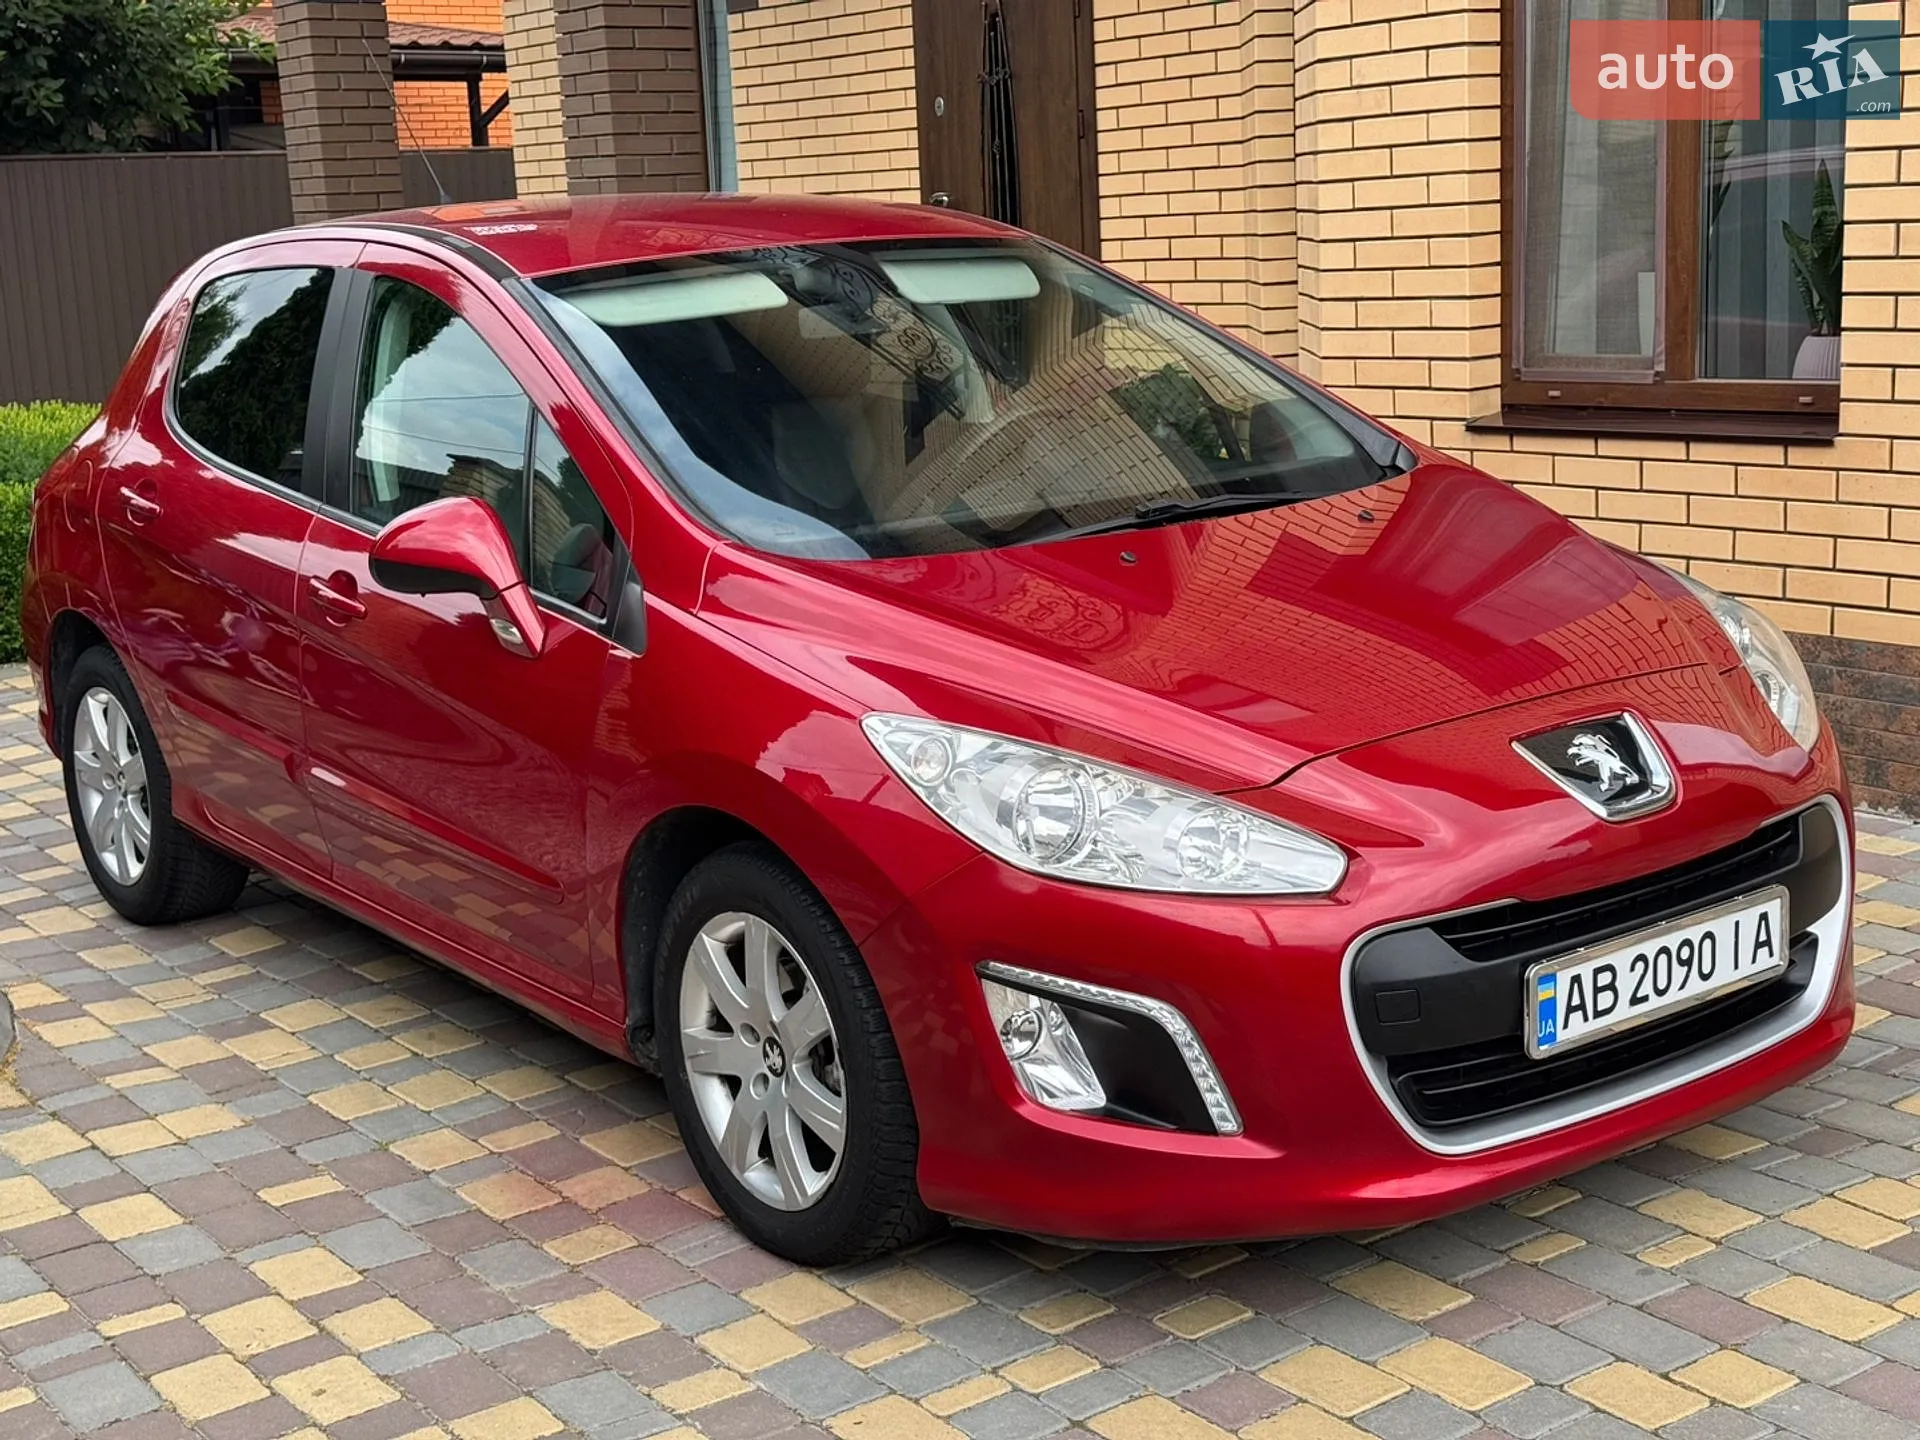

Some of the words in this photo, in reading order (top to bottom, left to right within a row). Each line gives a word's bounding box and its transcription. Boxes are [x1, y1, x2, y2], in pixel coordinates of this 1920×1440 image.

[1562, 963, 1619, 1030] AB
[1629, 930, 1716, 1007] 2090
[1733, 911, 1774, 970] IA
